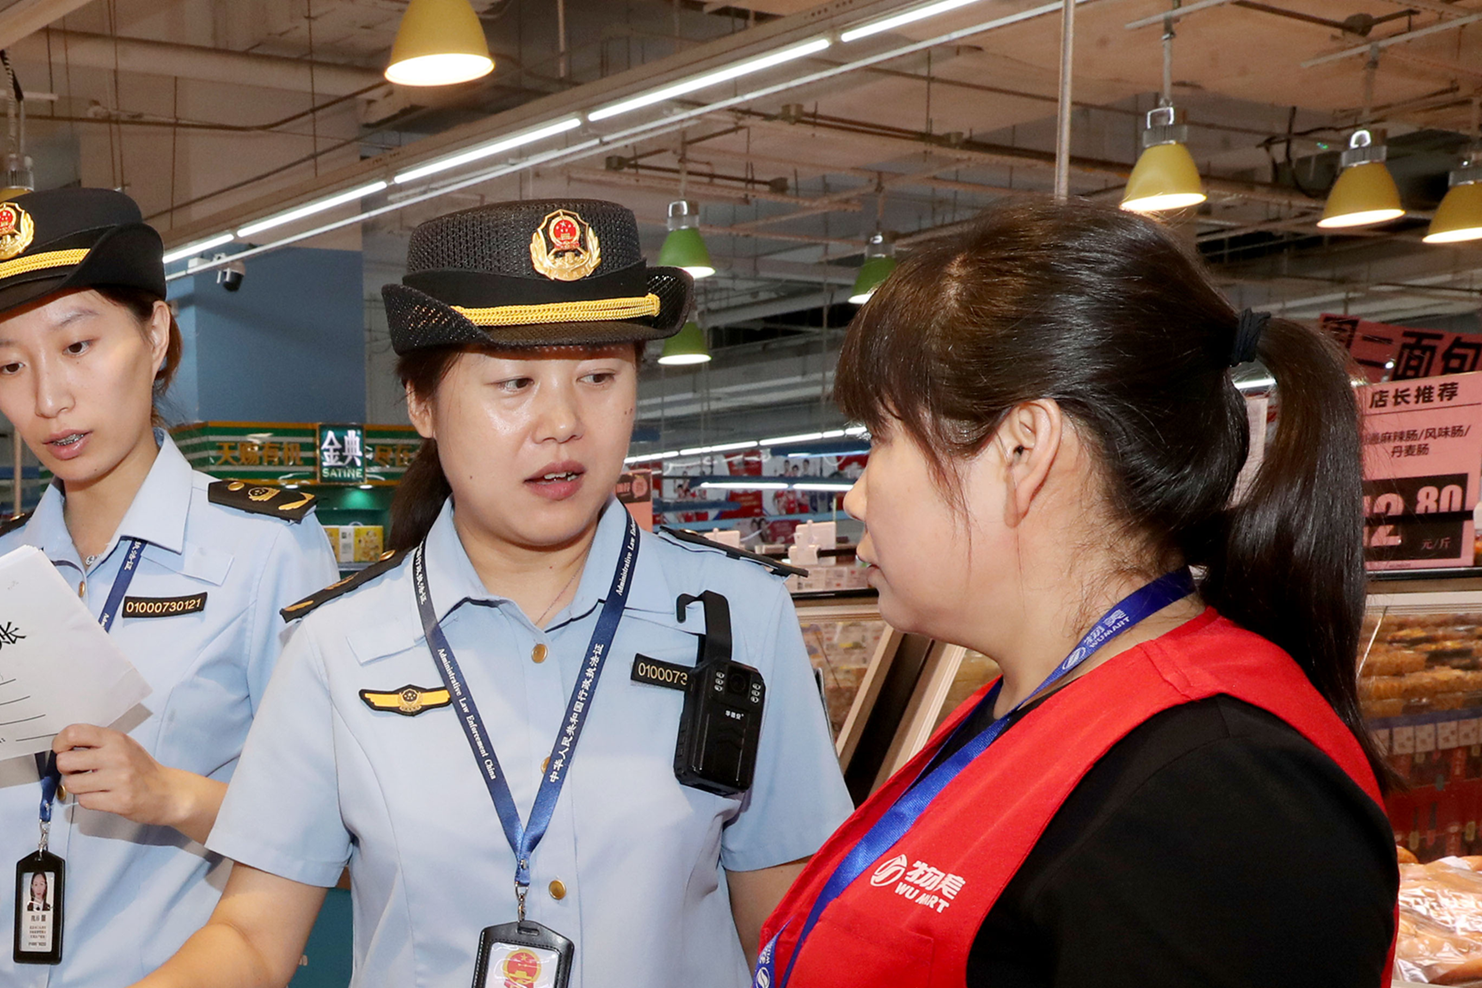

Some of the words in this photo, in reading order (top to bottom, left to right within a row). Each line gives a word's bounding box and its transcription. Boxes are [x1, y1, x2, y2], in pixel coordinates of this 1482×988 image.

[1369, 382, 1459, 409] 店长推荐
[320, 429, 363, 467] 金典
[1390, 443, 1430, 458] 丹麦肠
[321, 468, 364, 478] SATINE
[1422, 537, 1452, 550] 元/斤
[615, 551, 633, 596] Administrative
[629, 531, 637, 551] Law
[126, 598, 202, 614] 01000730121
[1083, 608, 1127, 646] 物美
[1088, 615, 1131, 648] WUMART
[437, 648, 462, 697] Administrative
[458, 697, 470, 714] Law
[466, 714, 488, 758] Enforcement
[484, 757, 497, 780] China
[549, 643, 605, 784] 中华人民共和国行政执法证
[905, 860, 967, 899] 物美
